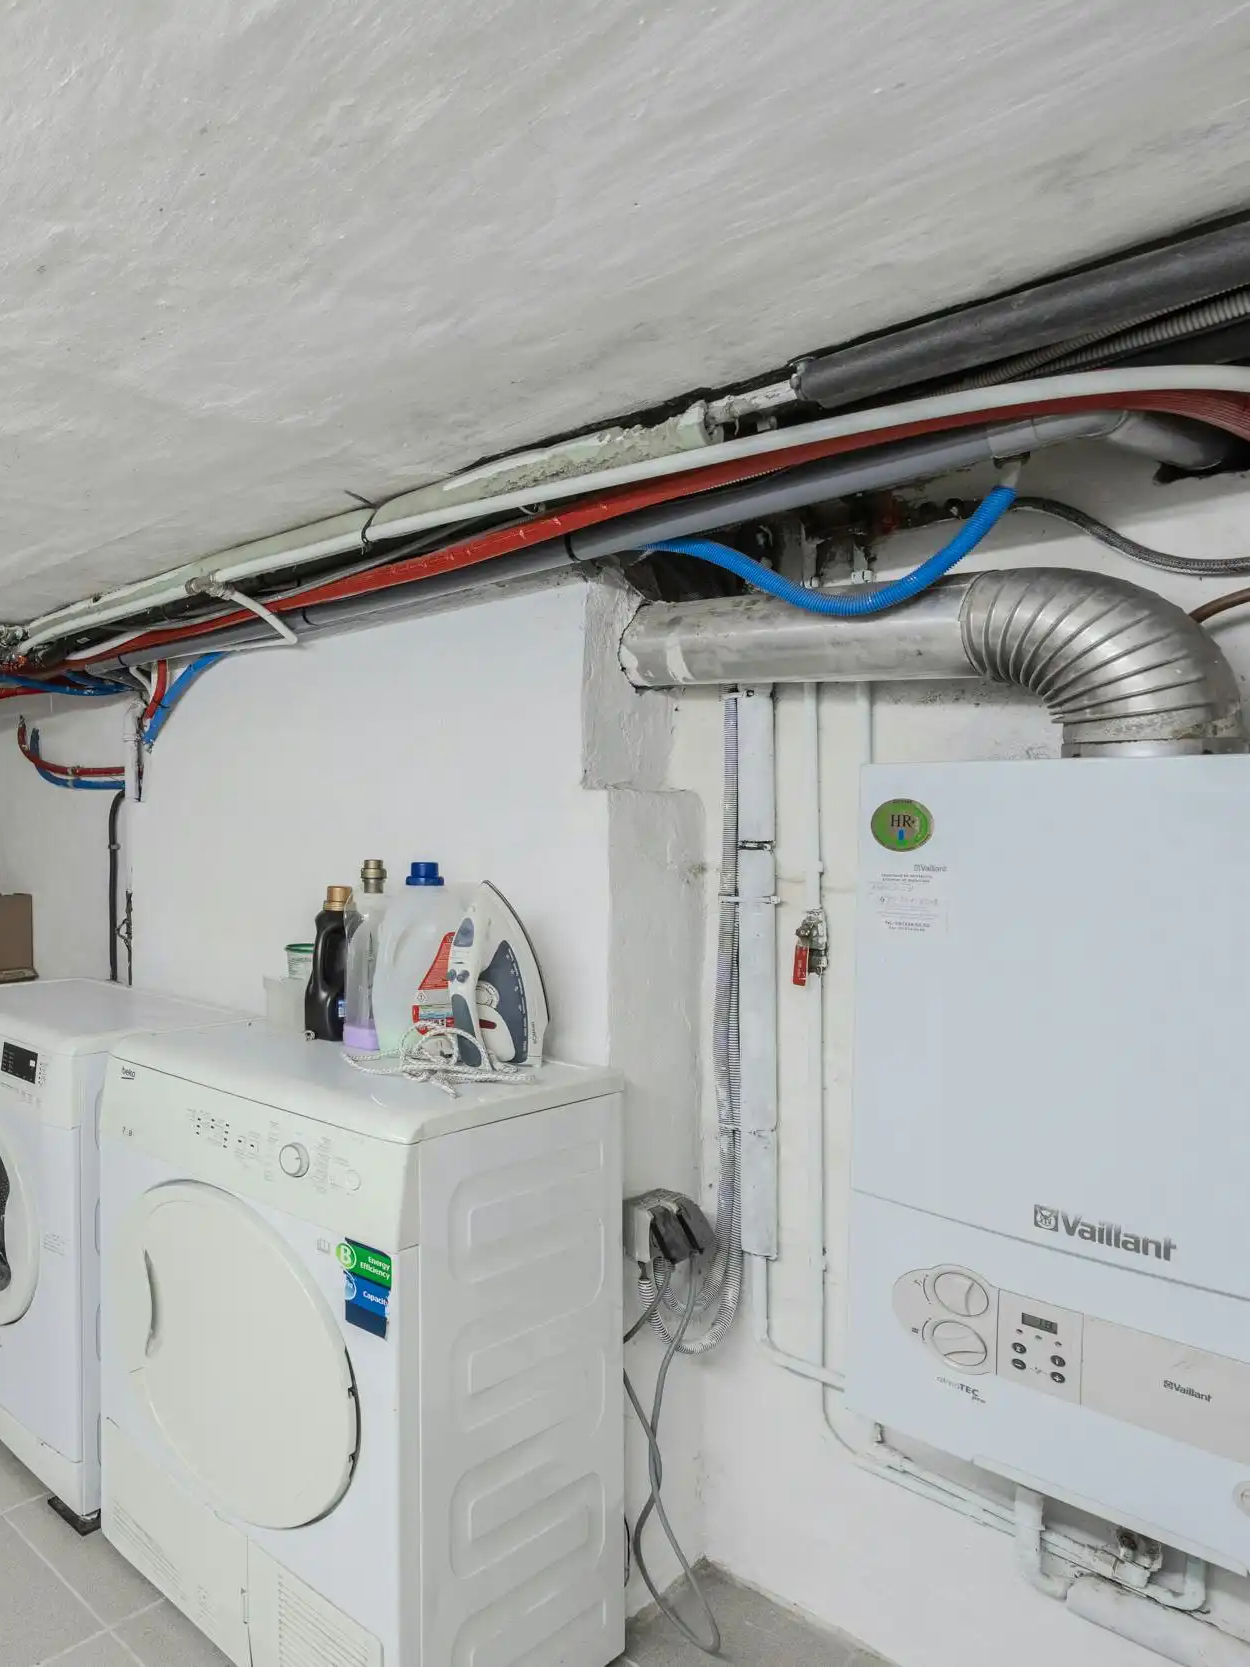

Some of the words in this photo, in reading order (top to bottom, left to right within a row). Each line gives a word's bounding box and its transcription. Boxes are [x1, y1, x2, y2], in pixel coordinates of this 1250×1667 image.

[1062, 1211, 1177, 1261] Vaillant
[360, 1262, 390, 1280] Efficiency
[368, 1256, 390, 1271] Energy
[1173, 1382, 1212, 1402] Vaillant
